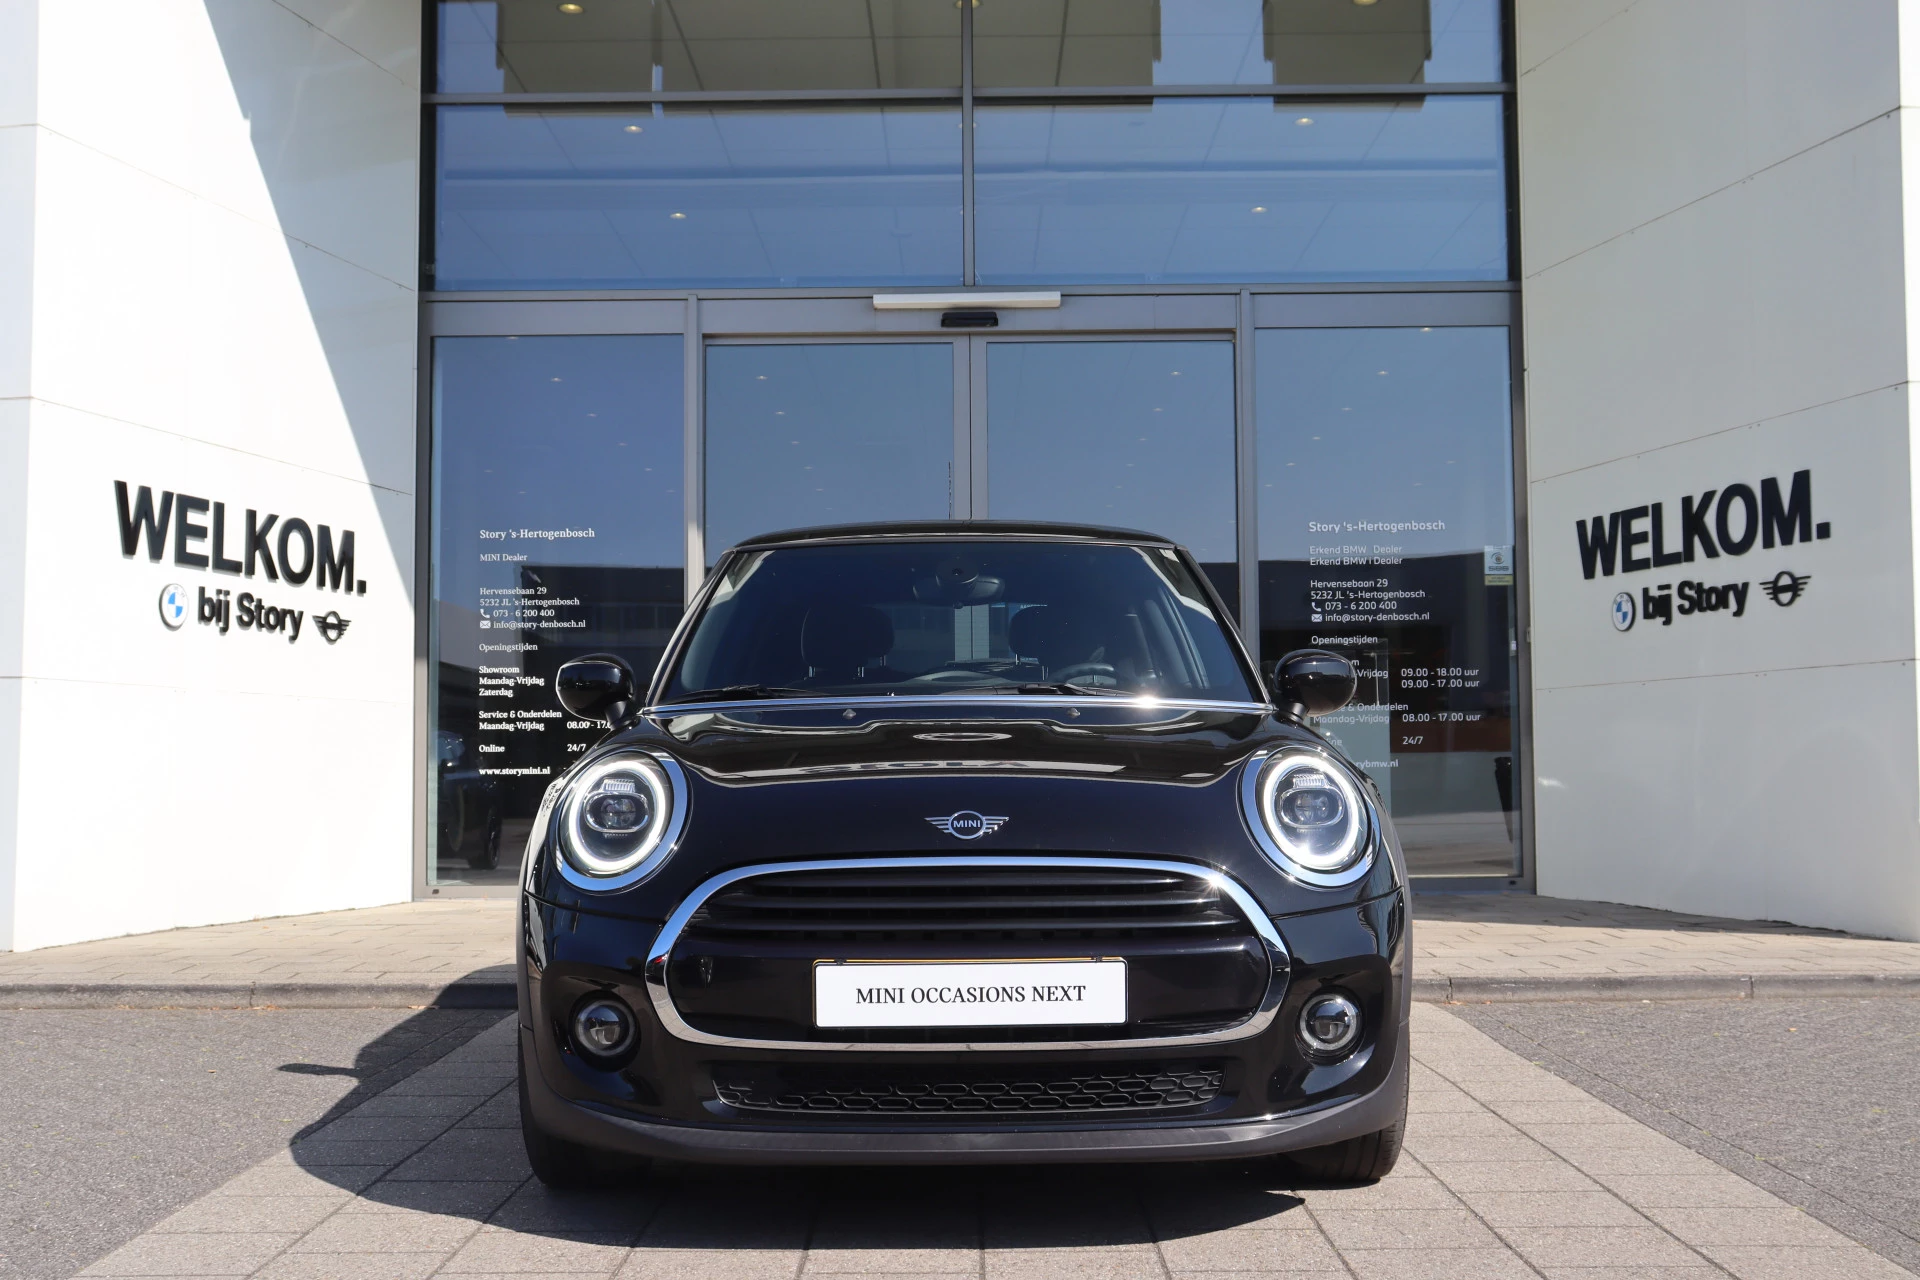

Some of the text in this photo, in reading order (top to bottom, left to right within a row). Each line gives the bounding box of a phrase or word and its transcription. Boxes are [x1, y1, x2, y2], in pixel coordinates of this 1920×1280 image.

[1308, 520, 1446, 534] Story 's-Hertogenbosch
[1575, 469, 1831, 580] WELKOM.
[114, 480, 367, 596] WELKOM.
[480, 530, 506, 541] Story
[1309, 544, 1402, 554] Erkend BMW Dealer
[480, 553, 528, 562] MINI Dealer
[1310, 556, 1341, 566] Erkend
[1343, 556, 1368, 566] BMW
[1373, 556, 1403, 566] Dealer
[1310, 578, 1388, 588] Hervensebaan 29
[480, 586, 547, 595] Hervensebaan 29
[1310, 590, 1426, 600] 5232 JL 's-Hertogenbosch
[1325, 602, 1342, 610] 073
[1350, 602, 1356, 610] 6
[1358, 602, 1377, 610] 200
[1379, 601, 1397, 610] 400
[1642, 580, 1750, 626] bij Story
[198, 586, 304, 643] bij Story
[493, 610, 508, 618] 073
[516, 609, 520, 617] 6
[522, 609, 538, 617] 200
[540, 609, 554, 617] 400
[1325, 612, 1430, 623] info@story-denbosch.nl
[493, 620, 586, 630] info@story-denbosch.nl
[1311, 635, 1378, 646] Openingstijden
[479, 643, 538, 652] Openingstijden
[1401, 668, 1428, 677] 09.00
[1437, 668, 1462, 677] 18.00
[479, 676, 545, 686] Maandag-Vrijdag
[1401, 679, 1429, 688] 09.00
[1437, 679, 1462, 688] 17.00
[479, 688, 514, 698] Zaterdag
[1348, 703, 1354, 711] &
[1357, 702, 1409, 711] Onderdelen
[479, 710, 508, 719] Service
[517, 709, 562, 718] Onderdelen
[1313, 713, 1389, 724] Maandag-Vrijdag
[1402, 713, 1430, 722] 08.00
[1438, 713, 1464, 722] 17.00
[479, 722, 545, 731] Maandag-Vrijdag
[567, 721, 590, 729] 08.00
[1402, 736, 1423, 745] 24/7
[479, 743, 586, 752] Online 24/7
[479, 766, 550, 776] www.storymini.nl
[953, 819, 981, 828] MINI
[856, 984, 1087, 1005] MINI OCCASIONS NEXT
